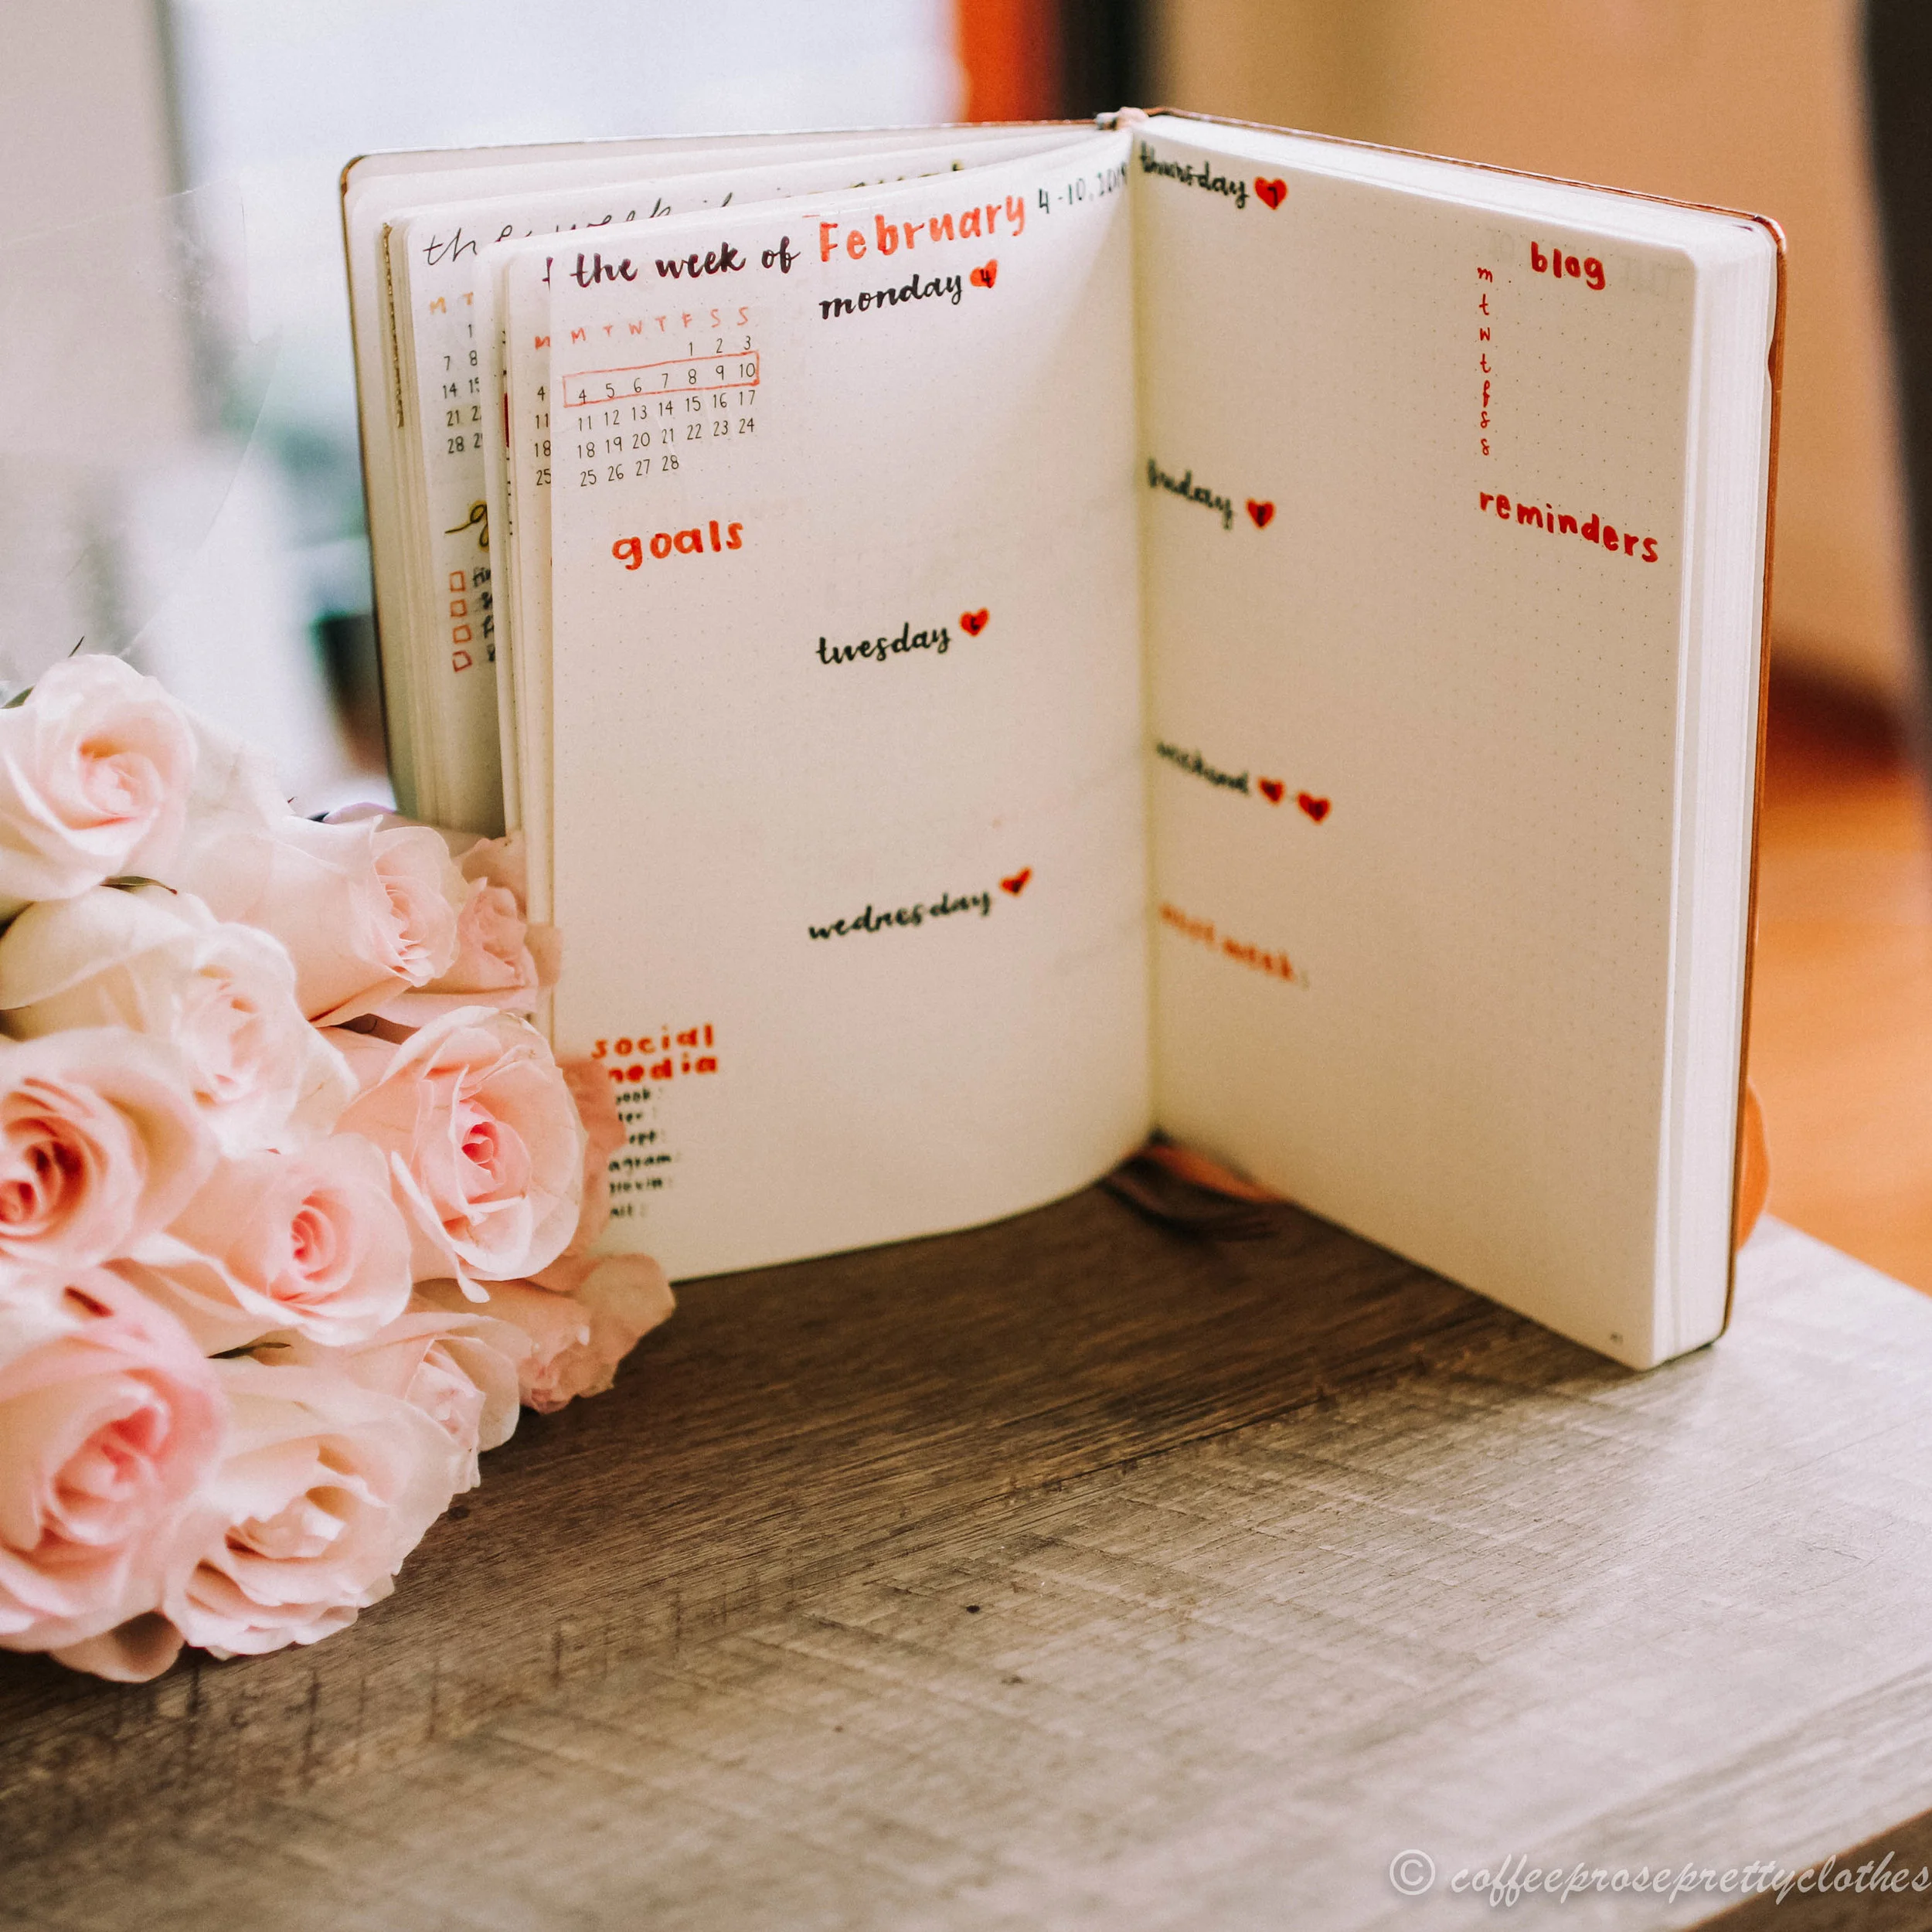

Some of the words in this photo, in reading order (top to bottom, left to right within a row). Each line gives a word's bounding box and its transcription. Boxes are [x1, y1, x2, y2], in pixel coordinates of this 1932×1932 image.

[569, 253, 638, 288] the
[655, 242, 747, 279] week
[762, 236, 801, 274] of
[819, 195, 1026, 262] February
[1478, 267, 1492, 283] m
[1530, 240, 1606, 291] blog
[430, 296, 446, 315] M
[818, 274, 963, 321] monday
[1478, 294, 1490, 316] t
[571, 328, 587, 344] M
[603, 325, 614, 337] T
[628, 320, 643, 335] W
[655, 315, 666, 332] T
[682, 312, 692, 328] F
[710, 308, 721, 328] S
[736, 306, 749, 326] S
[444, 355, 451, 371] 7
[469, 349, 478, 366] 8
[688, 342, 693, 356] 1
[716, 338, 723, 354] 2
[743, 335, 751, 351] 3
[1480, 353, 1492, 373] t
[442, 382, 457, 399] 14
[536, 386, 546, 402] 4
[578, 389, 587, 405] 4
[605, 383, 615, 399] 5
[633, 378, 642, 393] 6
[662, 373, 669, 389] 7
[688, 369, 697, 385] 8
[716, 365, 724, 381] 9
[740, 362, 756, 378] 10
[1482, 379, 1491, 408] f
[446, 410, 460, 427] 21
[471, 405, 482, 422] 2
[535, 413, 549, 429] 11
[578, 415, 592, 431] 11
[604, 409, 620, 426] 12
[631, 405, 648, 421] 13
[658, 400, 674, 417] 14
[685, 396, 701, 413] 15
[713, 393, 727, 409] 16
[739, 389, 756, 406] 17
[447, 435, 465, 454] 28
[473, 432, 483, 449] 2
[534, 440, 551, 457] 18
[577, 441, 595, 459] 18
[605, 436, 622, 454] 19
[632, 432, 651, 449] 20
[662, 428, 674, 444] 21
[686, 423, 702, 440] 22
[713, 420, 729, 437] 23
[739, 417, 755, 434] 24
[536, 468, 552, 485] 25
[580, 469, 597, 488] 25
[607, 464, 624, 481] 26
[635, 459, 651, 477] 27
[662, 454, 680, 472] 28
[1479, 491, 1658, 563] reminders
[611, 519, 744, 571] goals
[815, 621, 952, 665] tuesday
[808, 891, 992, 940] wednesday
[591, 1021, 714, 1060] social
